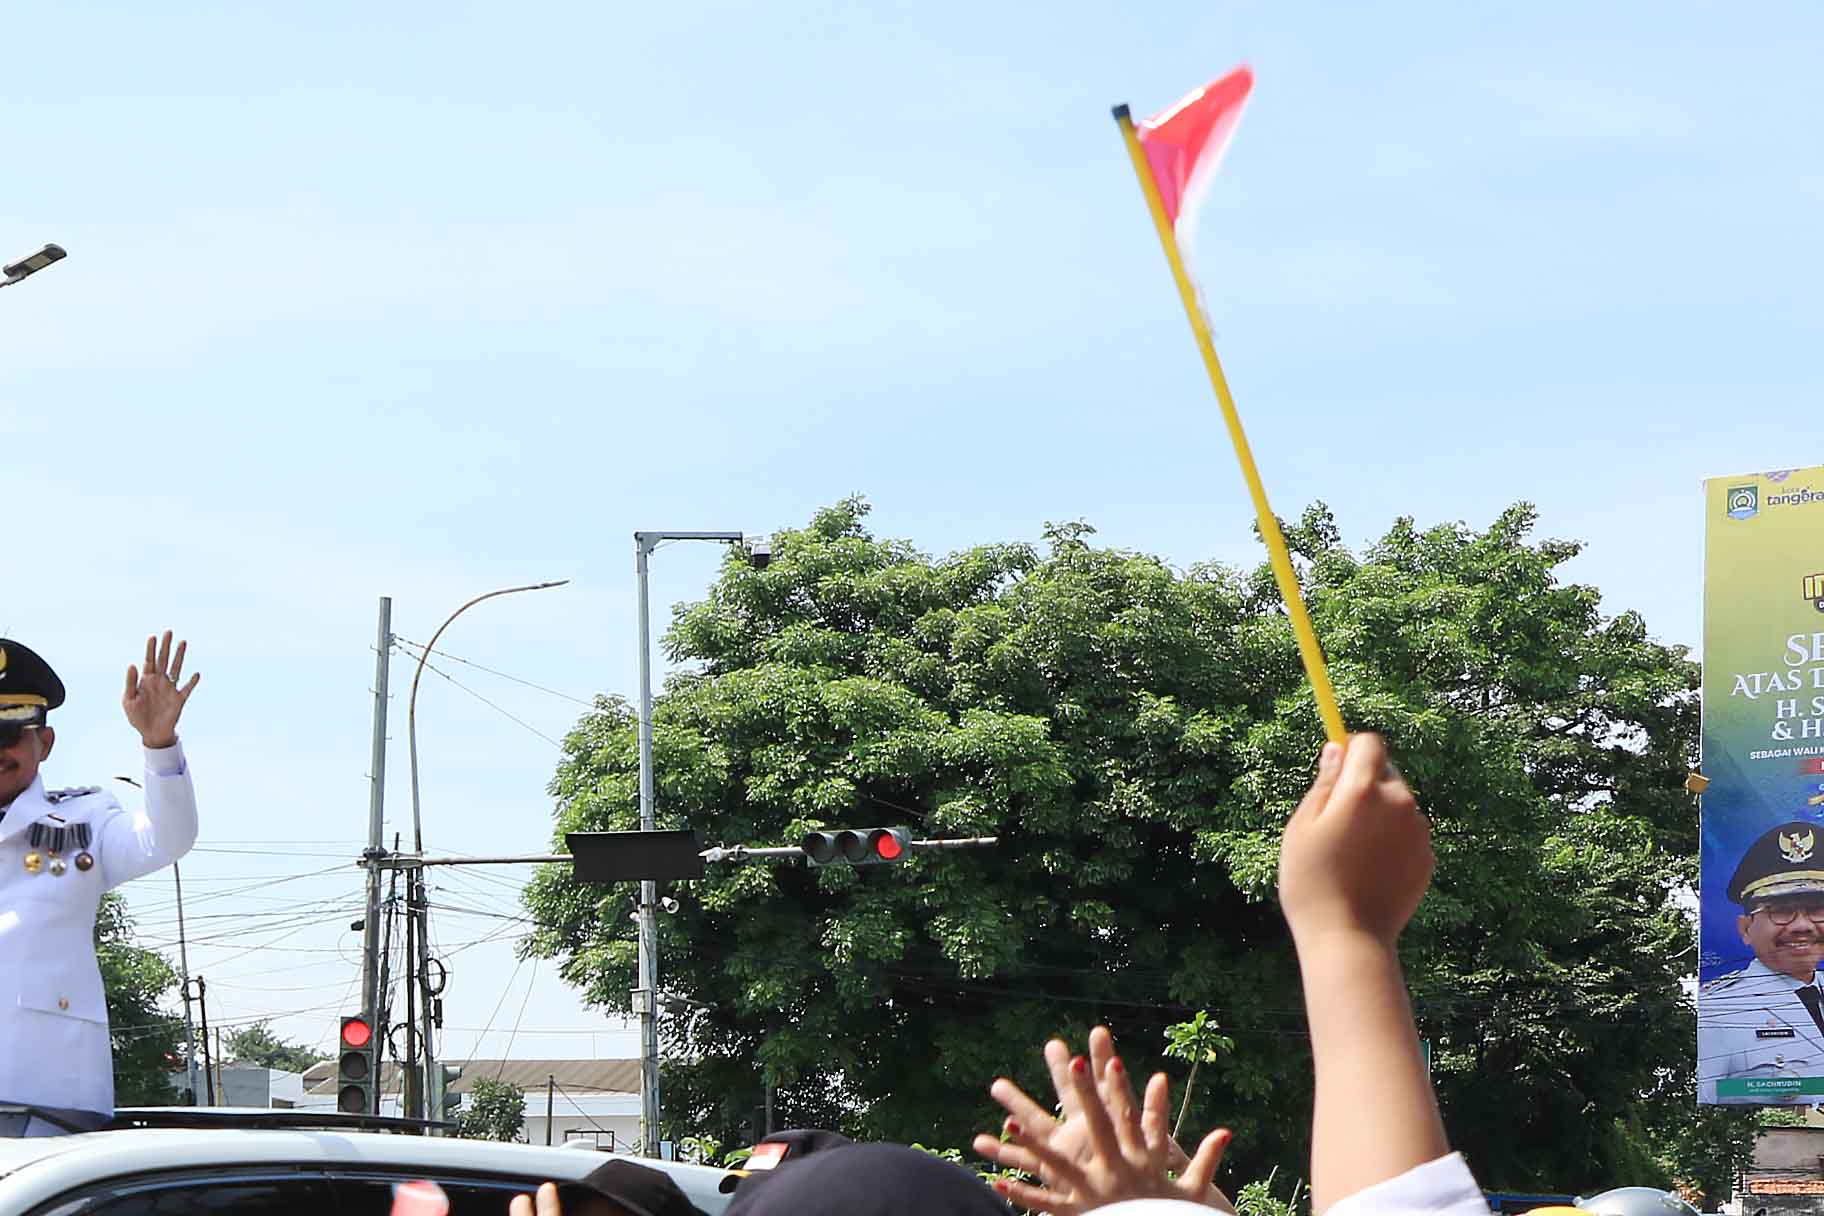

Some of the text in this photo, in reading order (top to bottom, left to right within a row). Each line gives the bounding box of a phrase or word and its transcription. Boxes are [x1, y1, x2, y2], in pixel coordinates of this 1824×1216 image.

[1730, 669, 1803, 700] ATAS
[1776, 698, 1804, 719] H.
[1772, 720, 1795, 741] &
[1749, 749, 1792, 760] SEBAGAI
[1792, 746, 1818, 757] WALI
